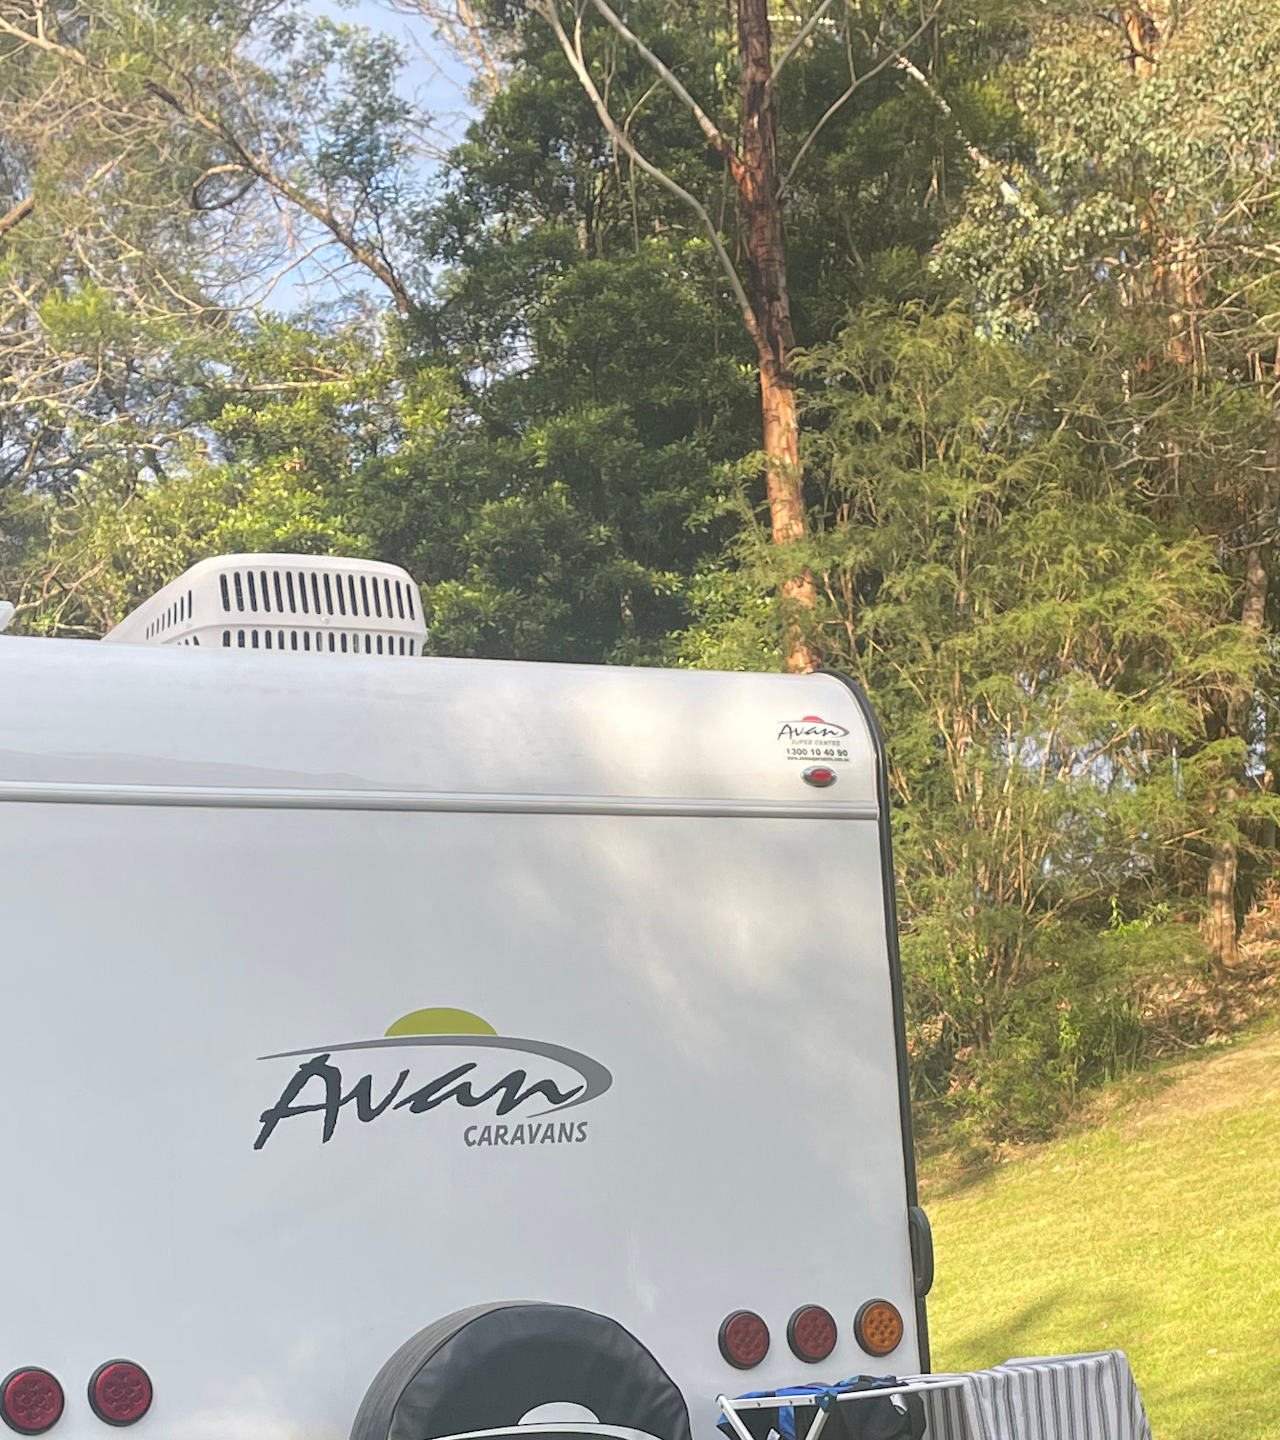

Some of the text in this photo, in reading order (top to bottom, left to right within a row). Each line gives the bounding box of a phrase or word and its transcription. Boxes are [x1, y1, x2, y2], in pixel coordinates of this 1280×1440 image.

[777, 724, 838, 741] Avan
[786, 748, 808, 756] 1300
[810, 748, 821, 756] 10
[823, 748, 835, 756] 40
[253, 1053, 585, 1150] Avan
[463, 1121, 588, 1147] CARAVANS
